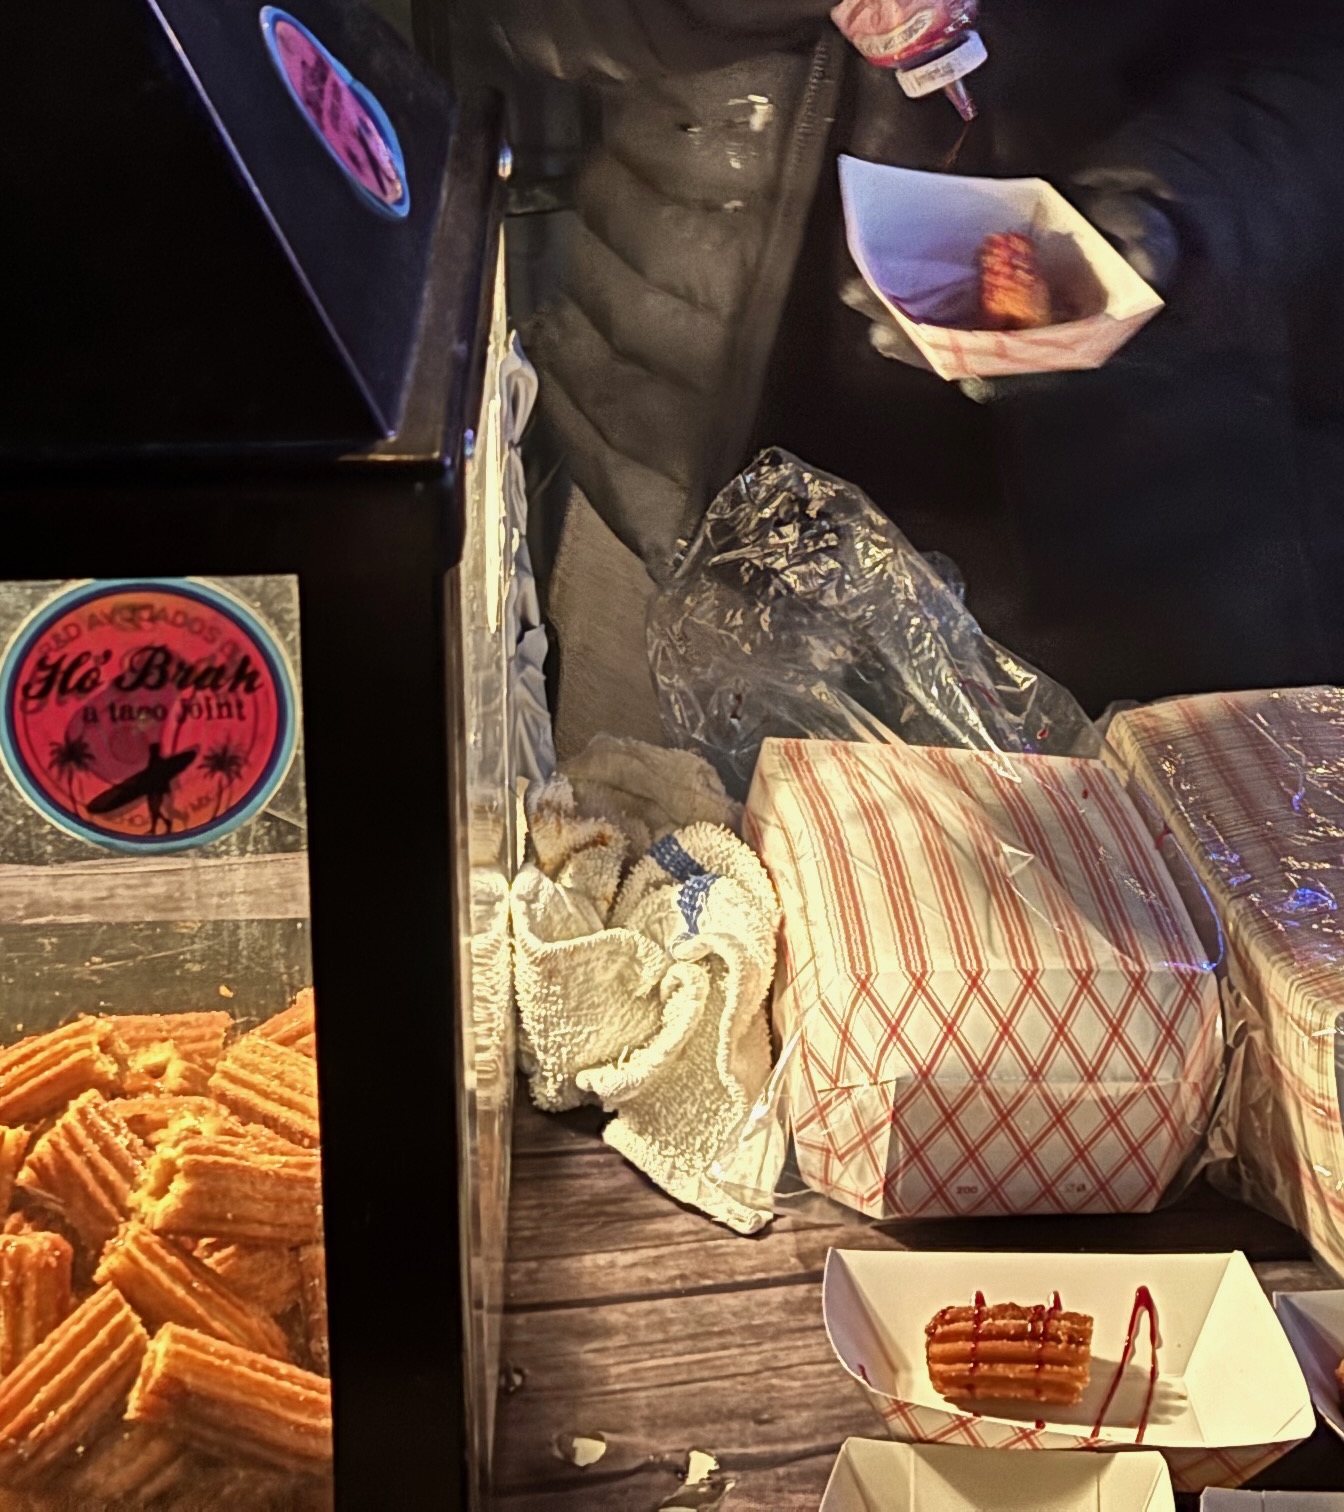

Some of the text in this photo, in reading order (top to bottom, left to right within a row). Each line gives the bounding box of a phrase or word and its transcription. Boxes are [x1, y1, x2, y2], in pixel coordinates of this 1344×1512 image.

[83, 697, 247, 723] a taco joint
